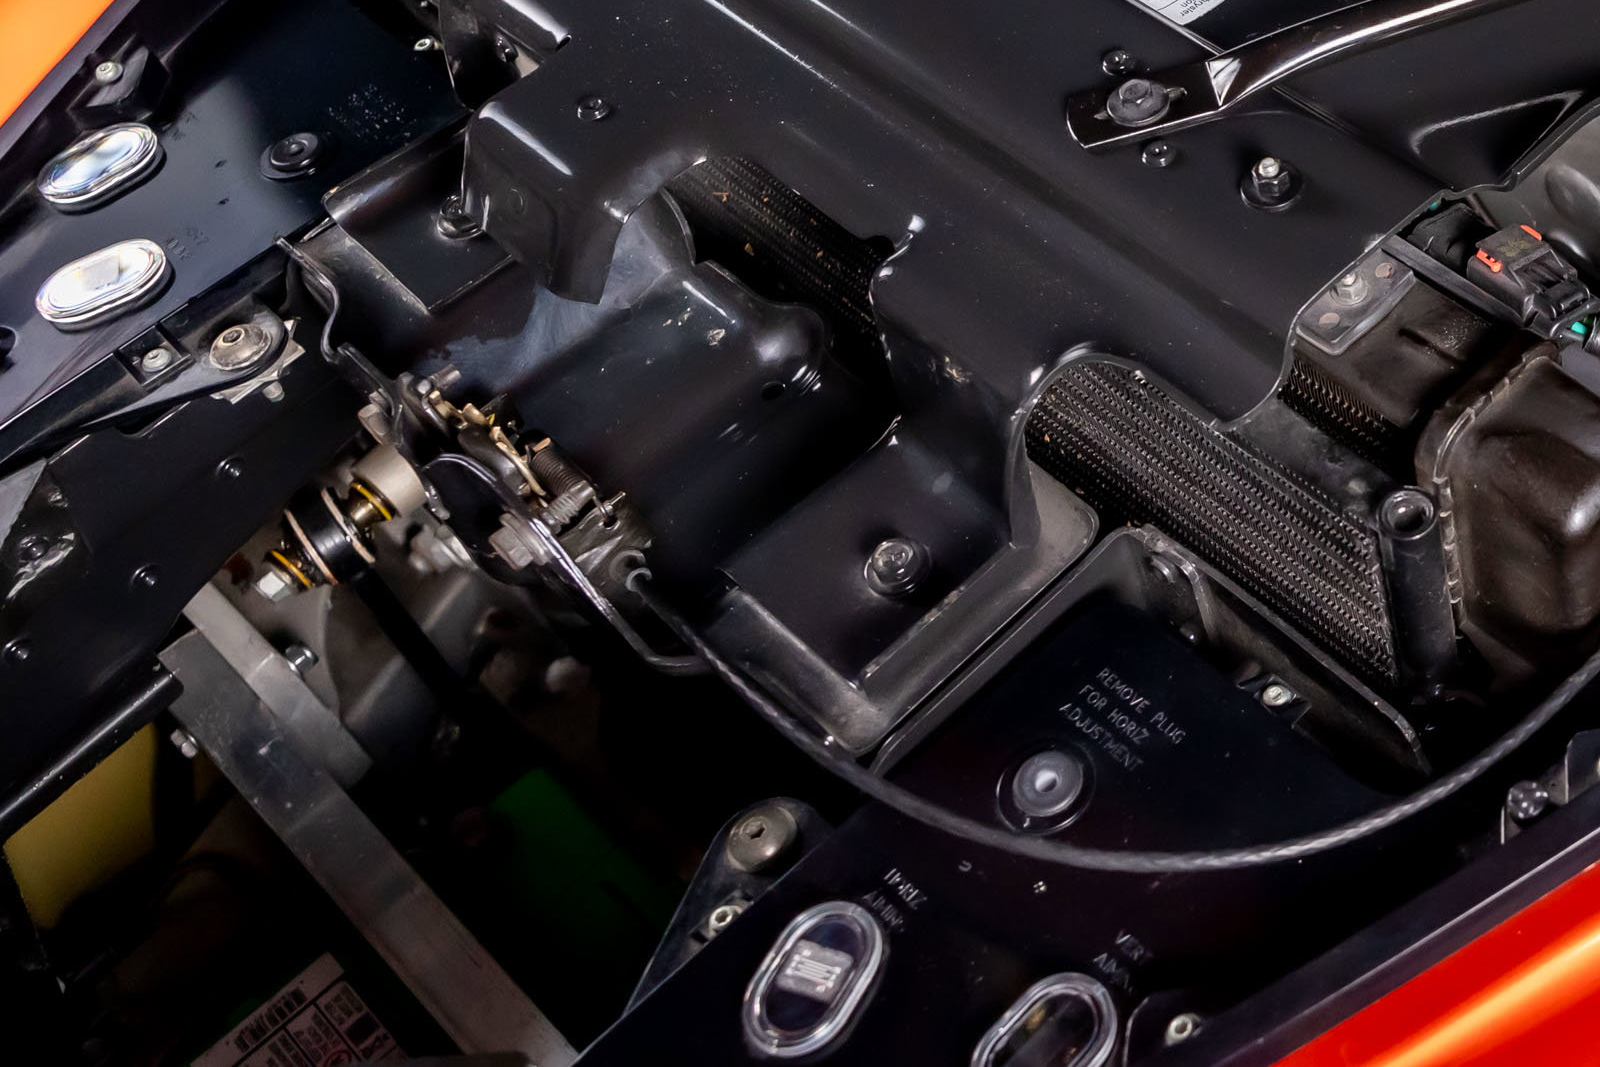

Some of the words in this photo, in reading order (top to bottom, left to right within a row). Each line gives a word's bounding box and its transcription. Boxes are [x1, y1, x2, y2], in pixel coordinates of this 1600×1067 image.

[1059, 703, 1144, 771] ADJUSTMENT
[1079, 684, 1108, 710] FOR
[1107, 708, 1150, 745] HORIZ
[1096, 668, 1151, 714] REMOVE
[1150, 711, 1186, 744] PLUG
